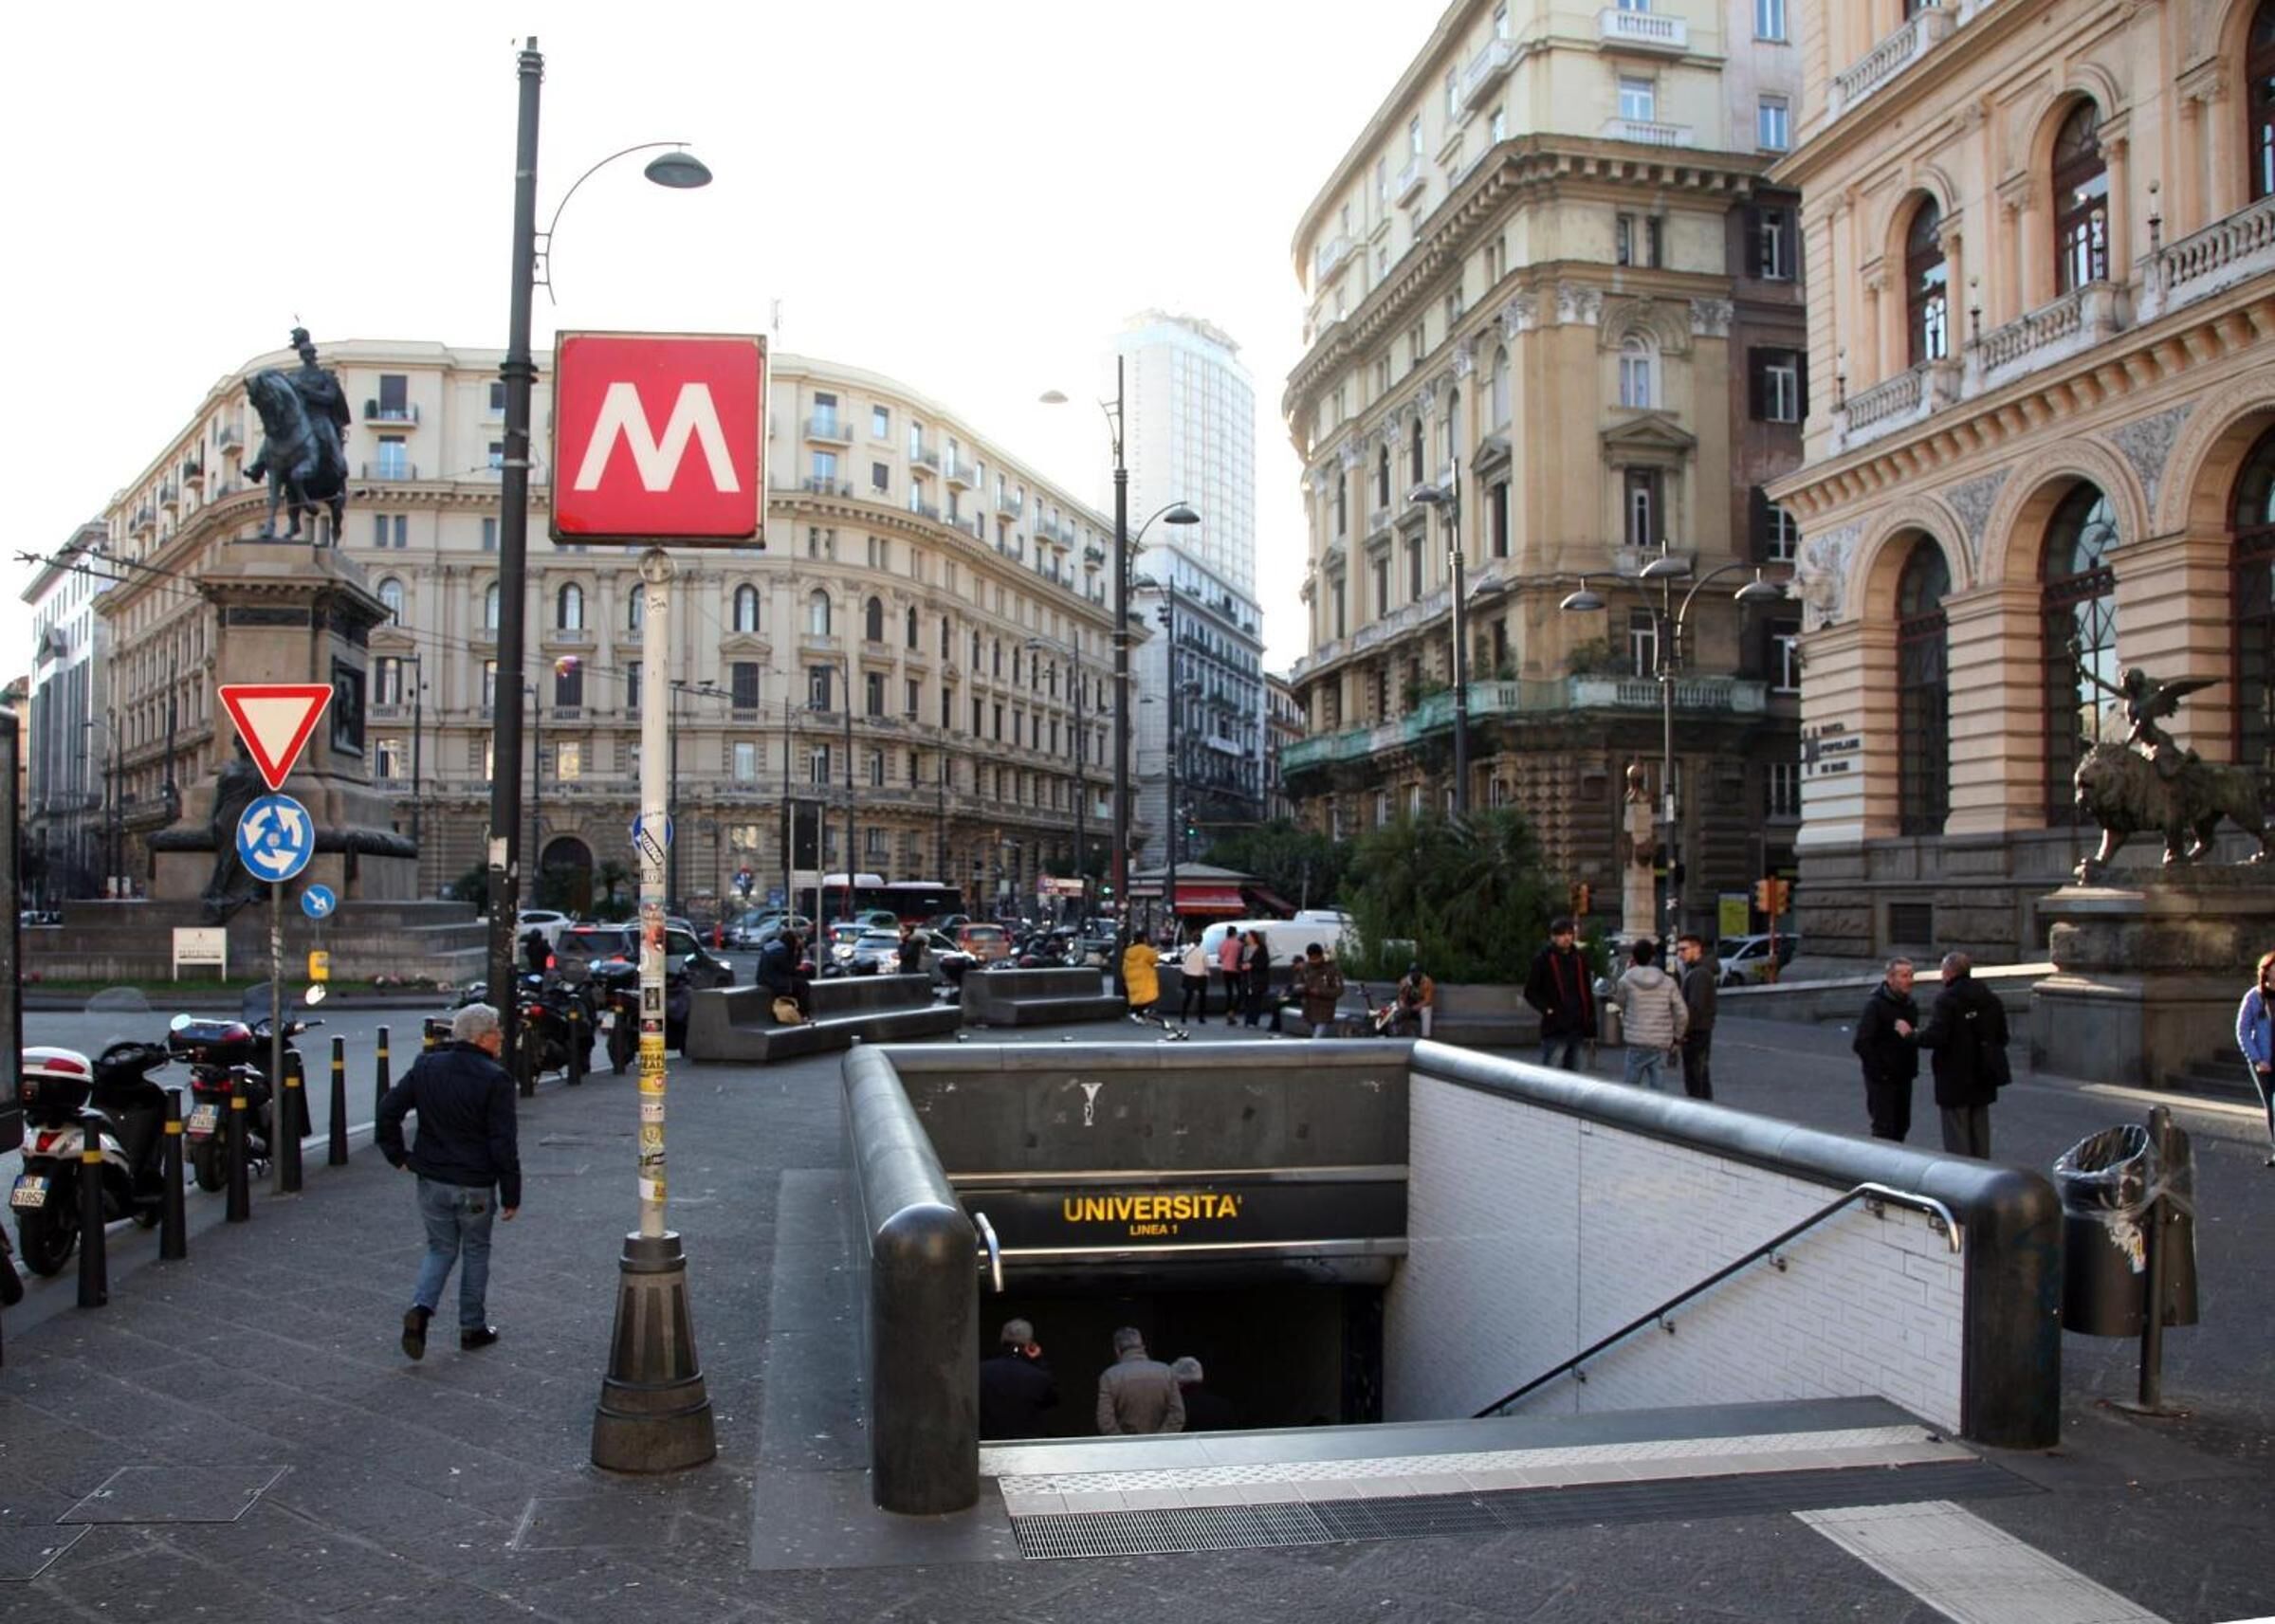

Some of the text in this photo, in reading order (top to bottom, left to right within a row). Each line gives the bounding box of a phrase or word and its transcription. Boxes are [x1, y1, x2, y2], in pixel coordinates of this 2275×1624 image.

[574, 382, 741, 492] M
[1129, 1224, 1179, 1236] LINEA 1
